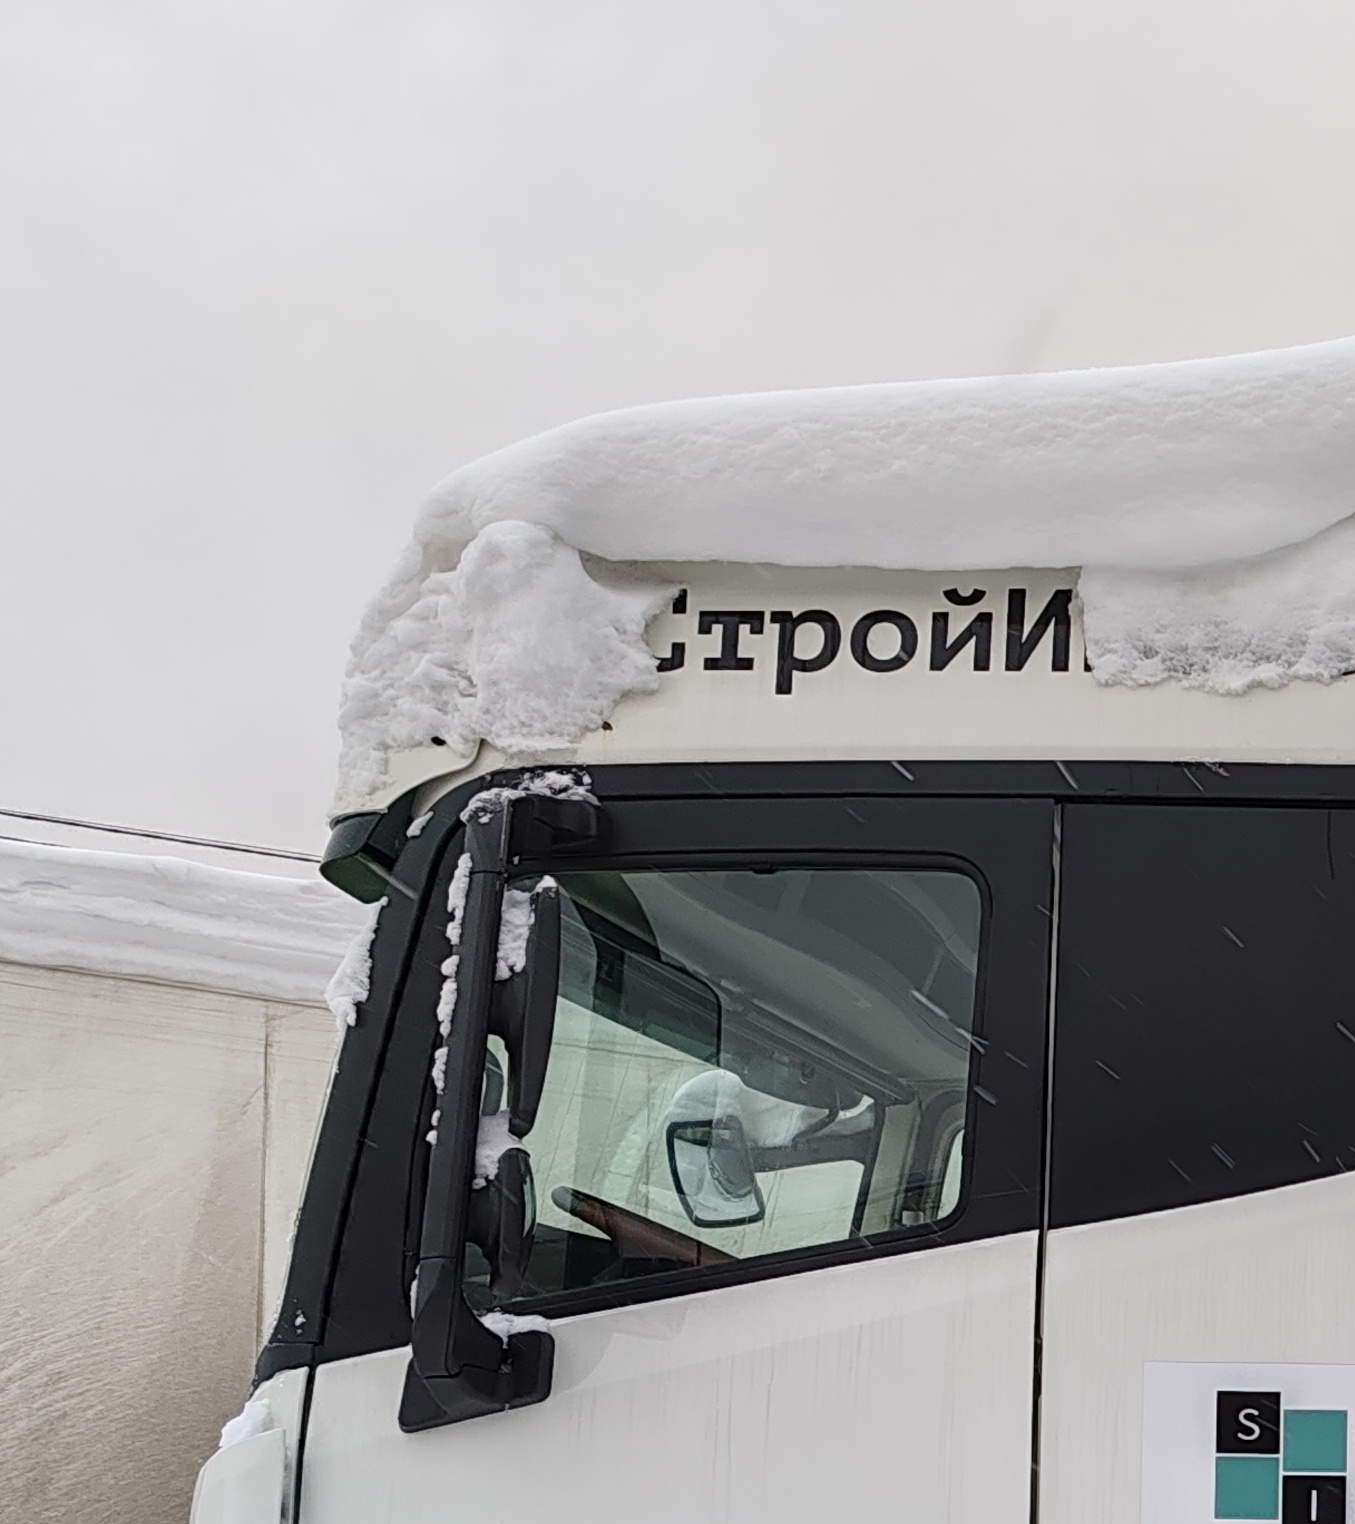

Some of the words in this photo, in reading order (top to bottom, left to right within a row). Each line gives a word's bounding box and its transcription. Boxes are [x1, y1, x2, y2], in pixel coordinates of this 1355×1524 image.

[656, 588, 1092, 695] тройИ
[1237, 1408, 1261, 1440] S
[1310, 1489, 1318, 1521] I
